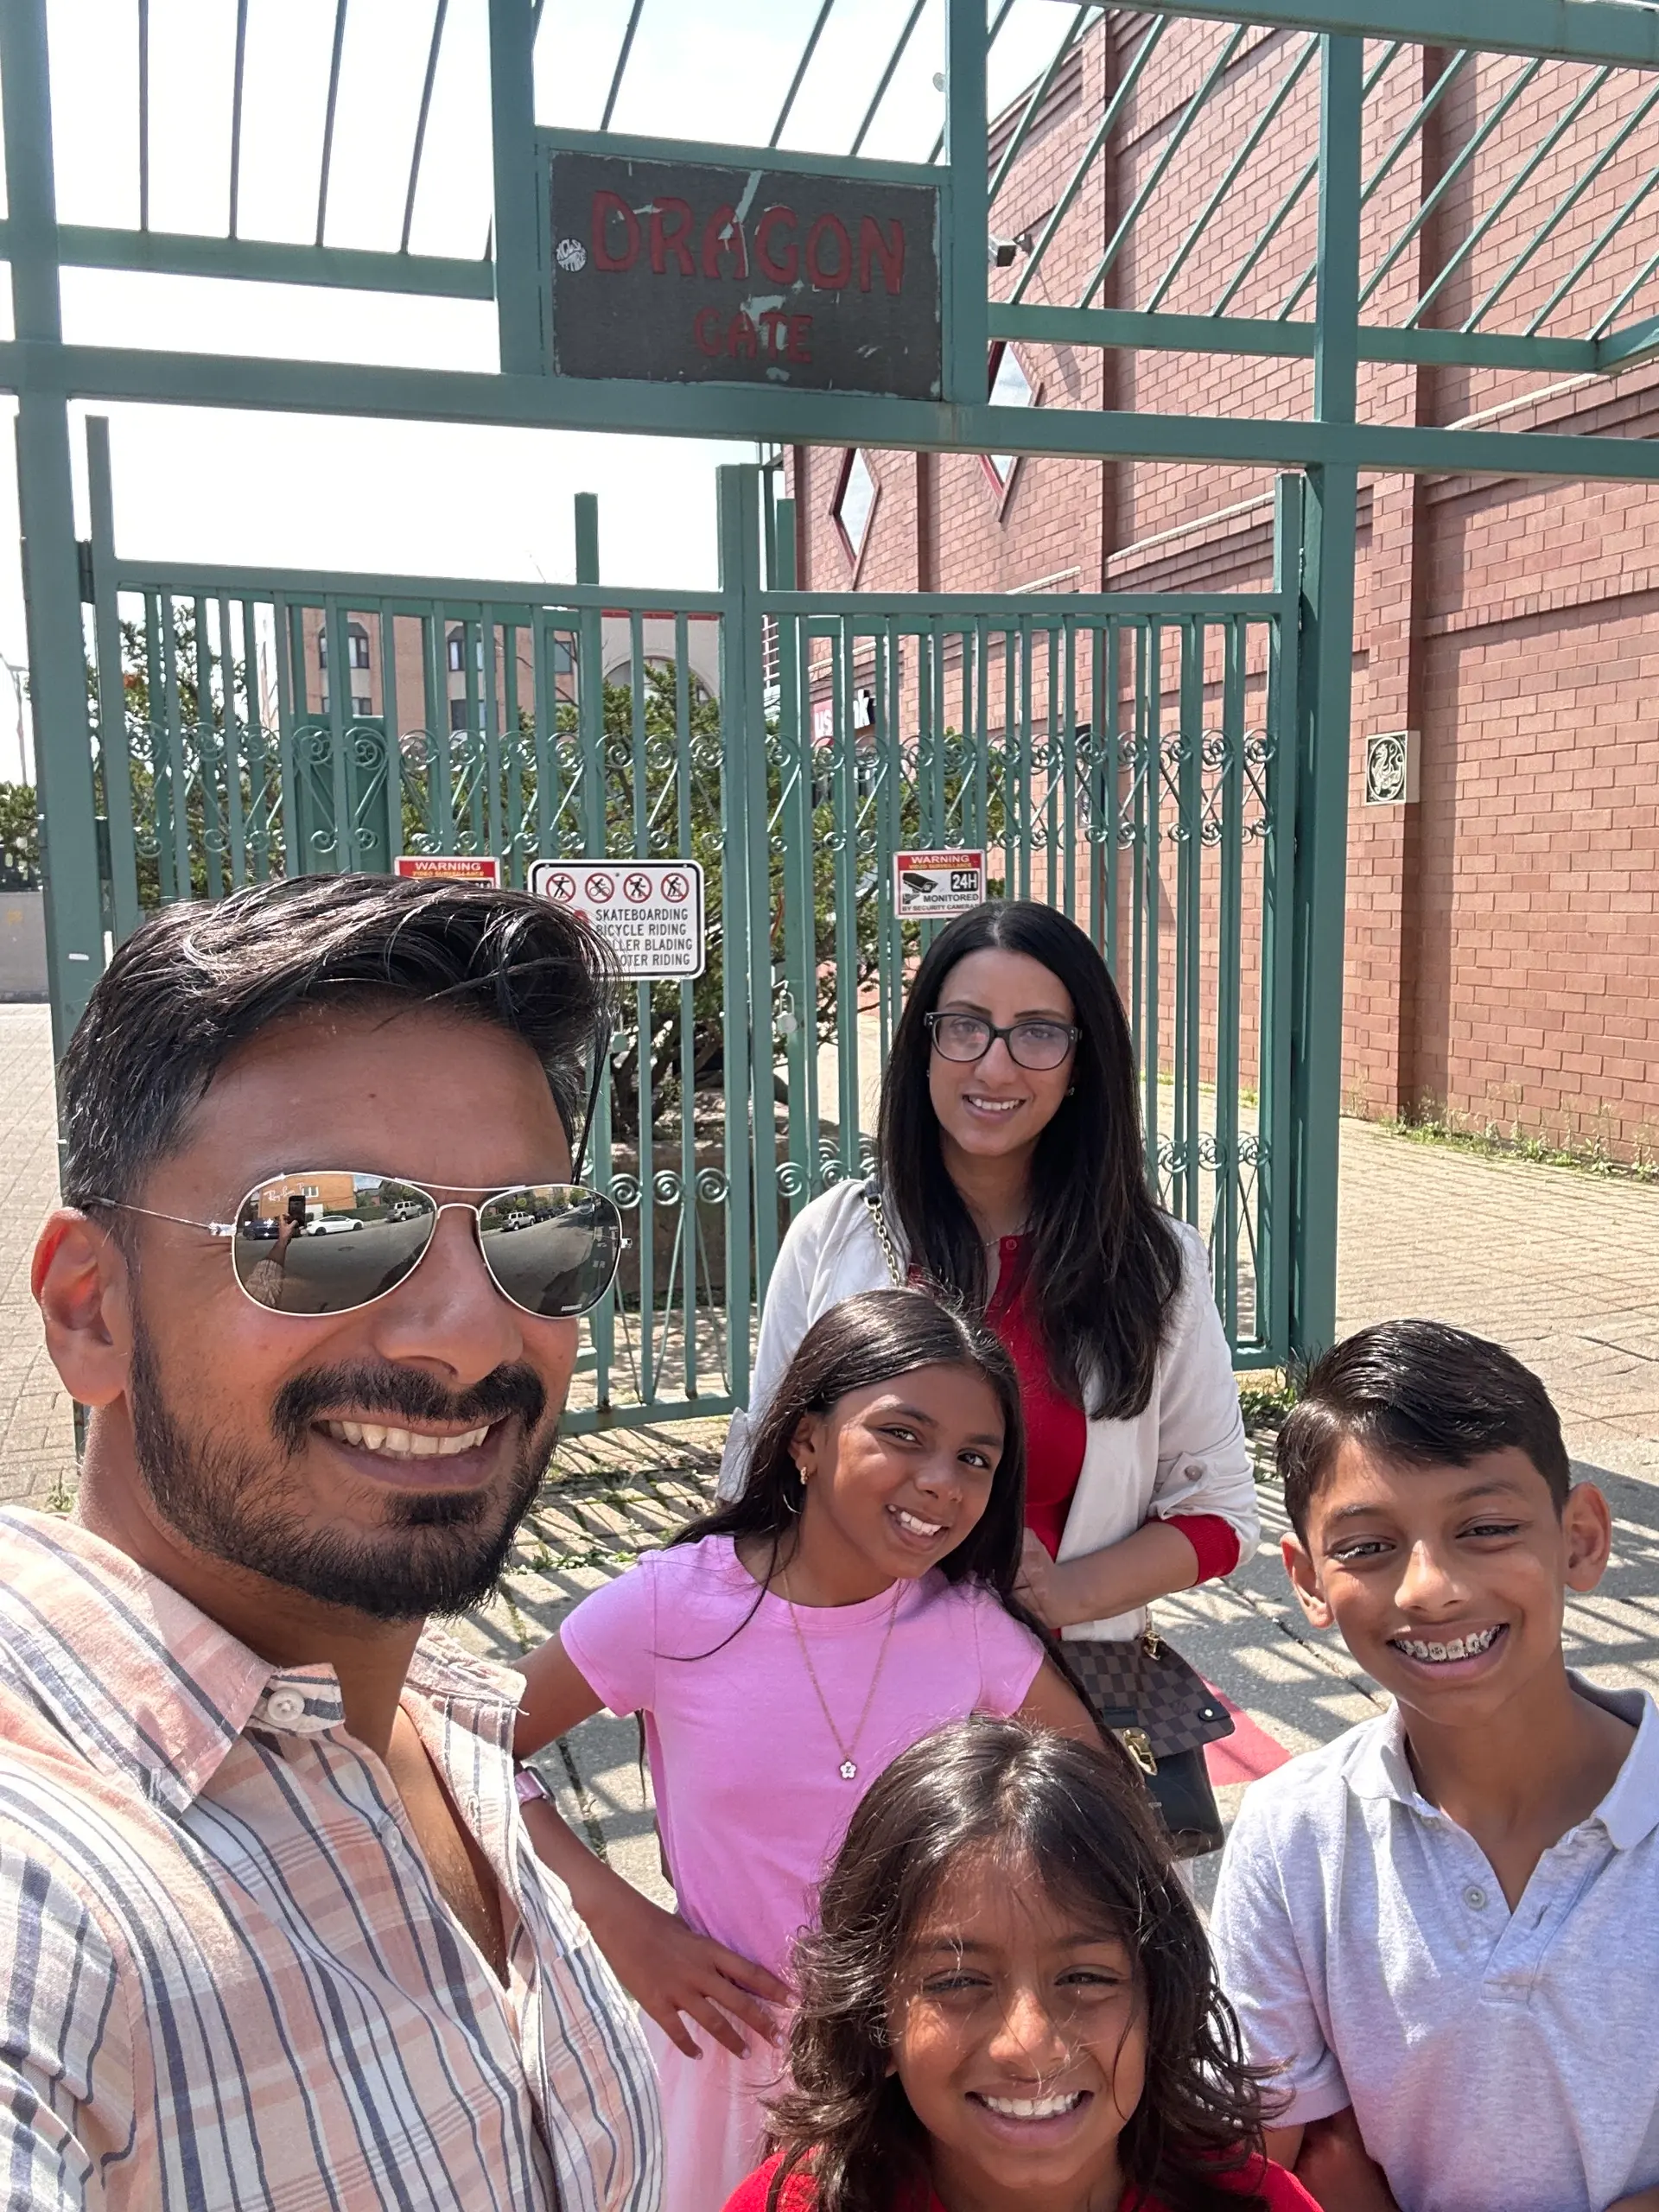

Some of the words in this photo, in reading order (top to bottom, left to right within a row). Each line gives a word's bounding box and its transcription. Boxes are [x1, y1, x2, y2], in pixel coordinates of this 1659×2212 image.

[591, 190, 906, 296] DRAGON
[694, 306, 813, 364] GATE
[911, 855, 969, 863] WARNING
[415, 861, 481, 870] WARNING
[952, 874, 977, 889] 24H
[923, 893, 979, 902] MONITORED
[595, 908, 689, 921] SKATEBOARDING
[596, 924, 645, 936] BICYCLE
[649, 924, 687, 936] RIDING
[645, 938, 692, 950] BLADING
[652, 953, 690, 965] RIDING
